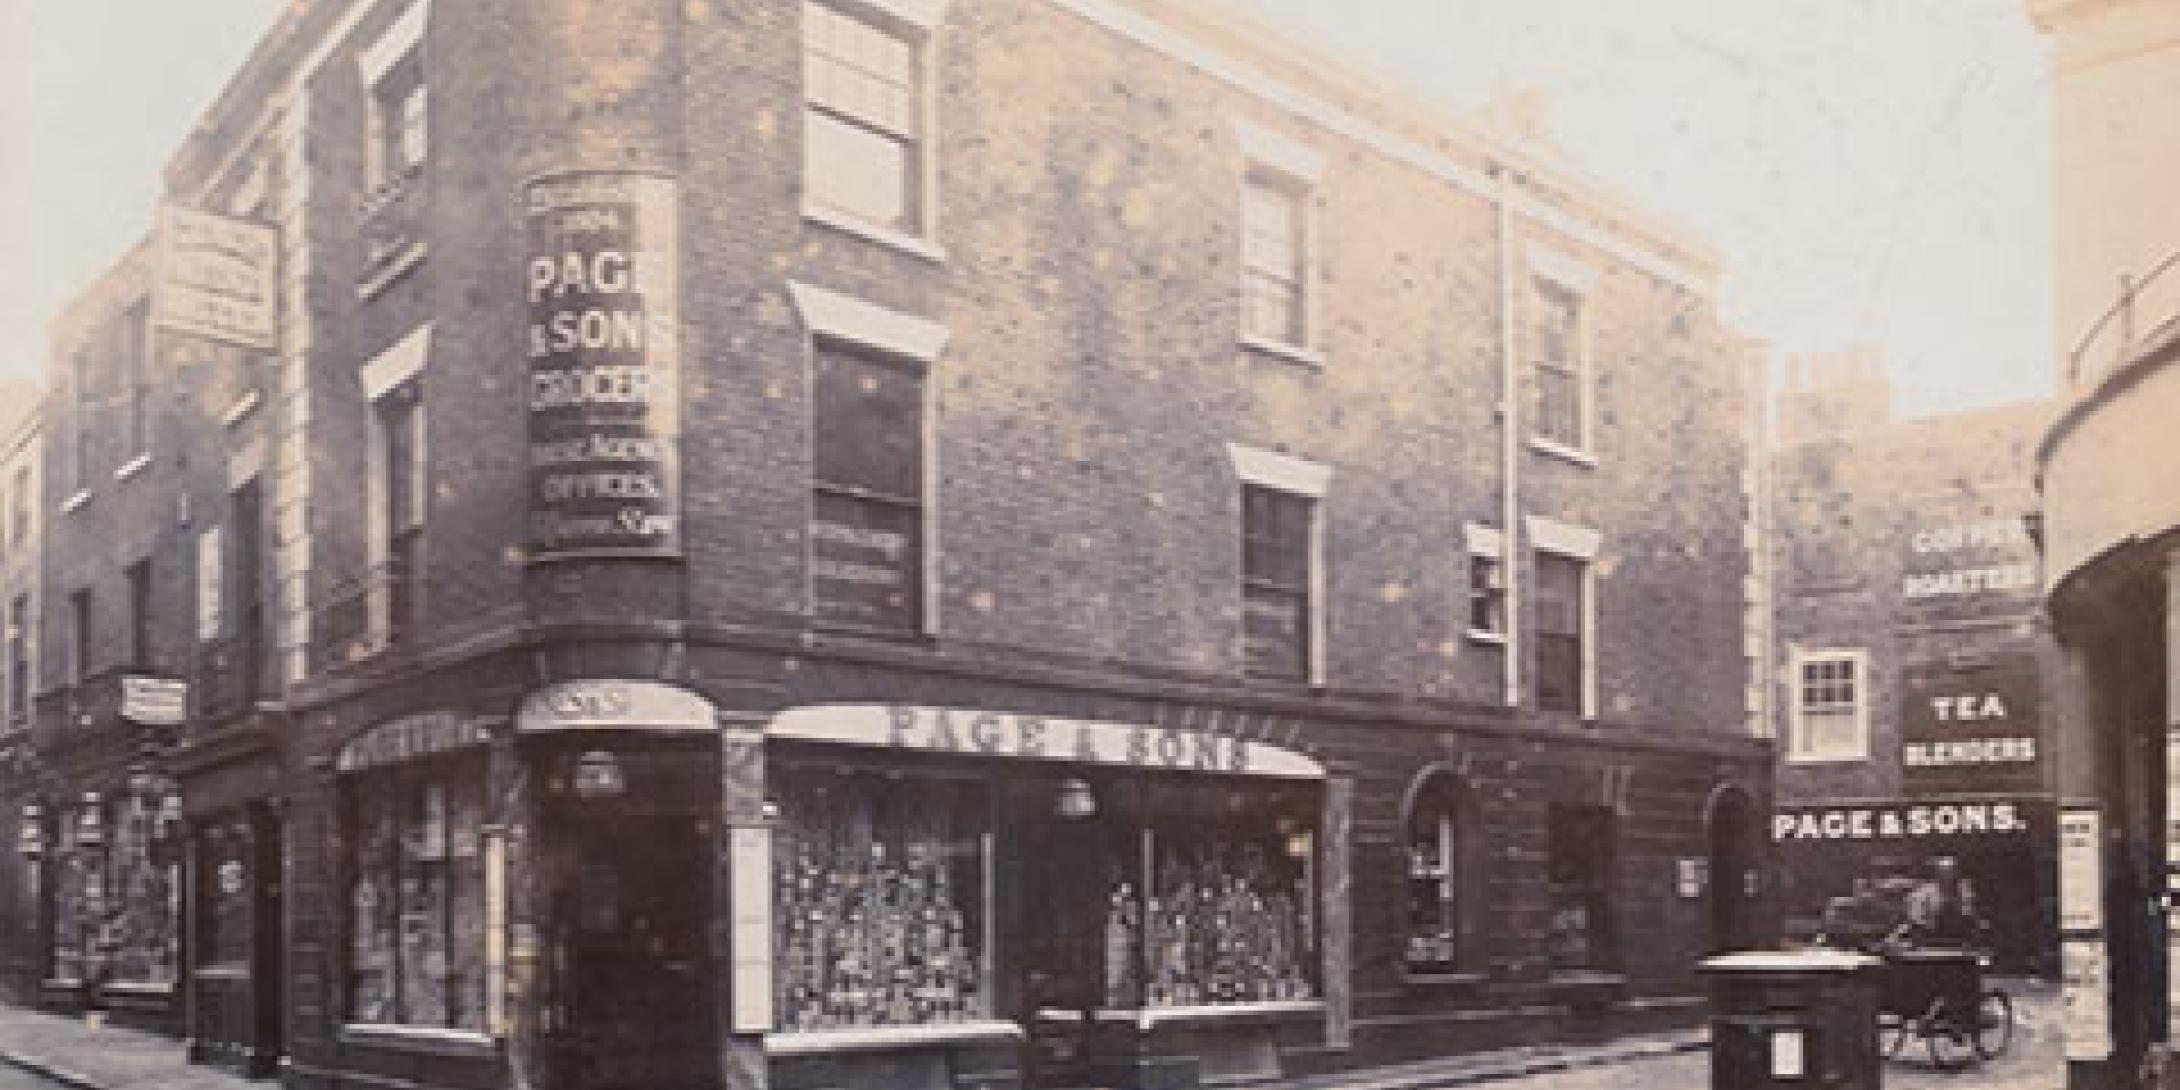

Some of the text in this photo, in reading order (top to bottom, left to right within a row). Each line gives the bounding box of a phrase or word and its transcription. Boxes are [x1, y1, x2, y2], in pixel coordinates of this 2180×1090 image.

[1930, 693, 2007, 721] TEA
[888, 704, 1047, 756] PAGE
[1126, 727, 1250, 773] SONS
[1903, 738, 2036, 766] BLENDERS
[1772, 810, 1873, 841] PAGE
[1880, 812, 1904, 837] &
